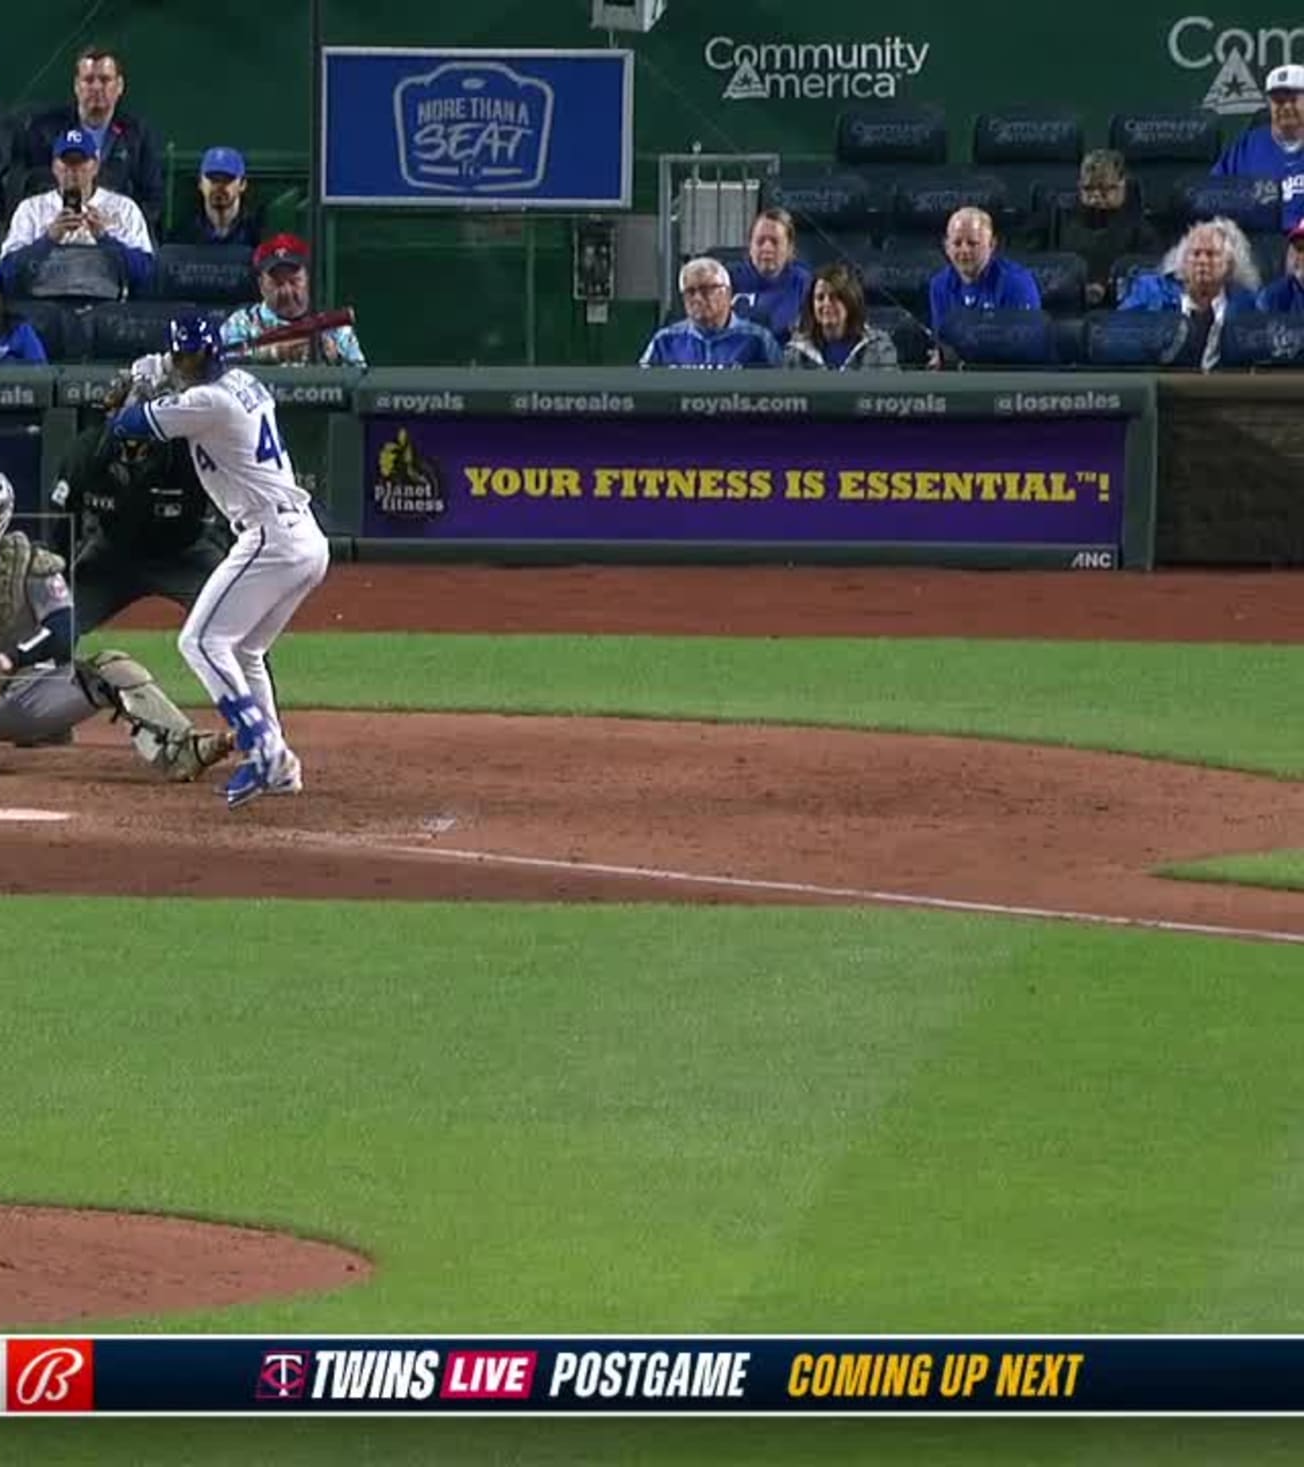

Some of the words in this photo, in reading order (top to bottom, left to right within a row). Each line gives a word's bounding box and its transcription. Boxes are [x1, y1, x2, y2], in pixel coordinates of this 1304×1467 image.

[705, 36, 930, 74] Community
[722, 55, 897, 98] America
[418, 99, 465, 125] MORE
[469, 97, 515, 123] THAN
[517, 103, 530, 123] A
[413, 121, 533, 162] SEAT
[376, 392, 464, 415] @royals
[514, 392, 635, 413] @losreales
[680, 393, 808, 414] royals.com
[858, 394, 947, 415] @royals
[998, 392, 1121, 413] @losreales
[375, 483, 432, 501] planet
[464, 467, 582, 498] YOUR
[594, 468, 772, 499] FITNESS
[785, 470, 826, 499] IS
[382, 496, 445, 513] fitness
[1071, 552, 1112, 568] ANC
